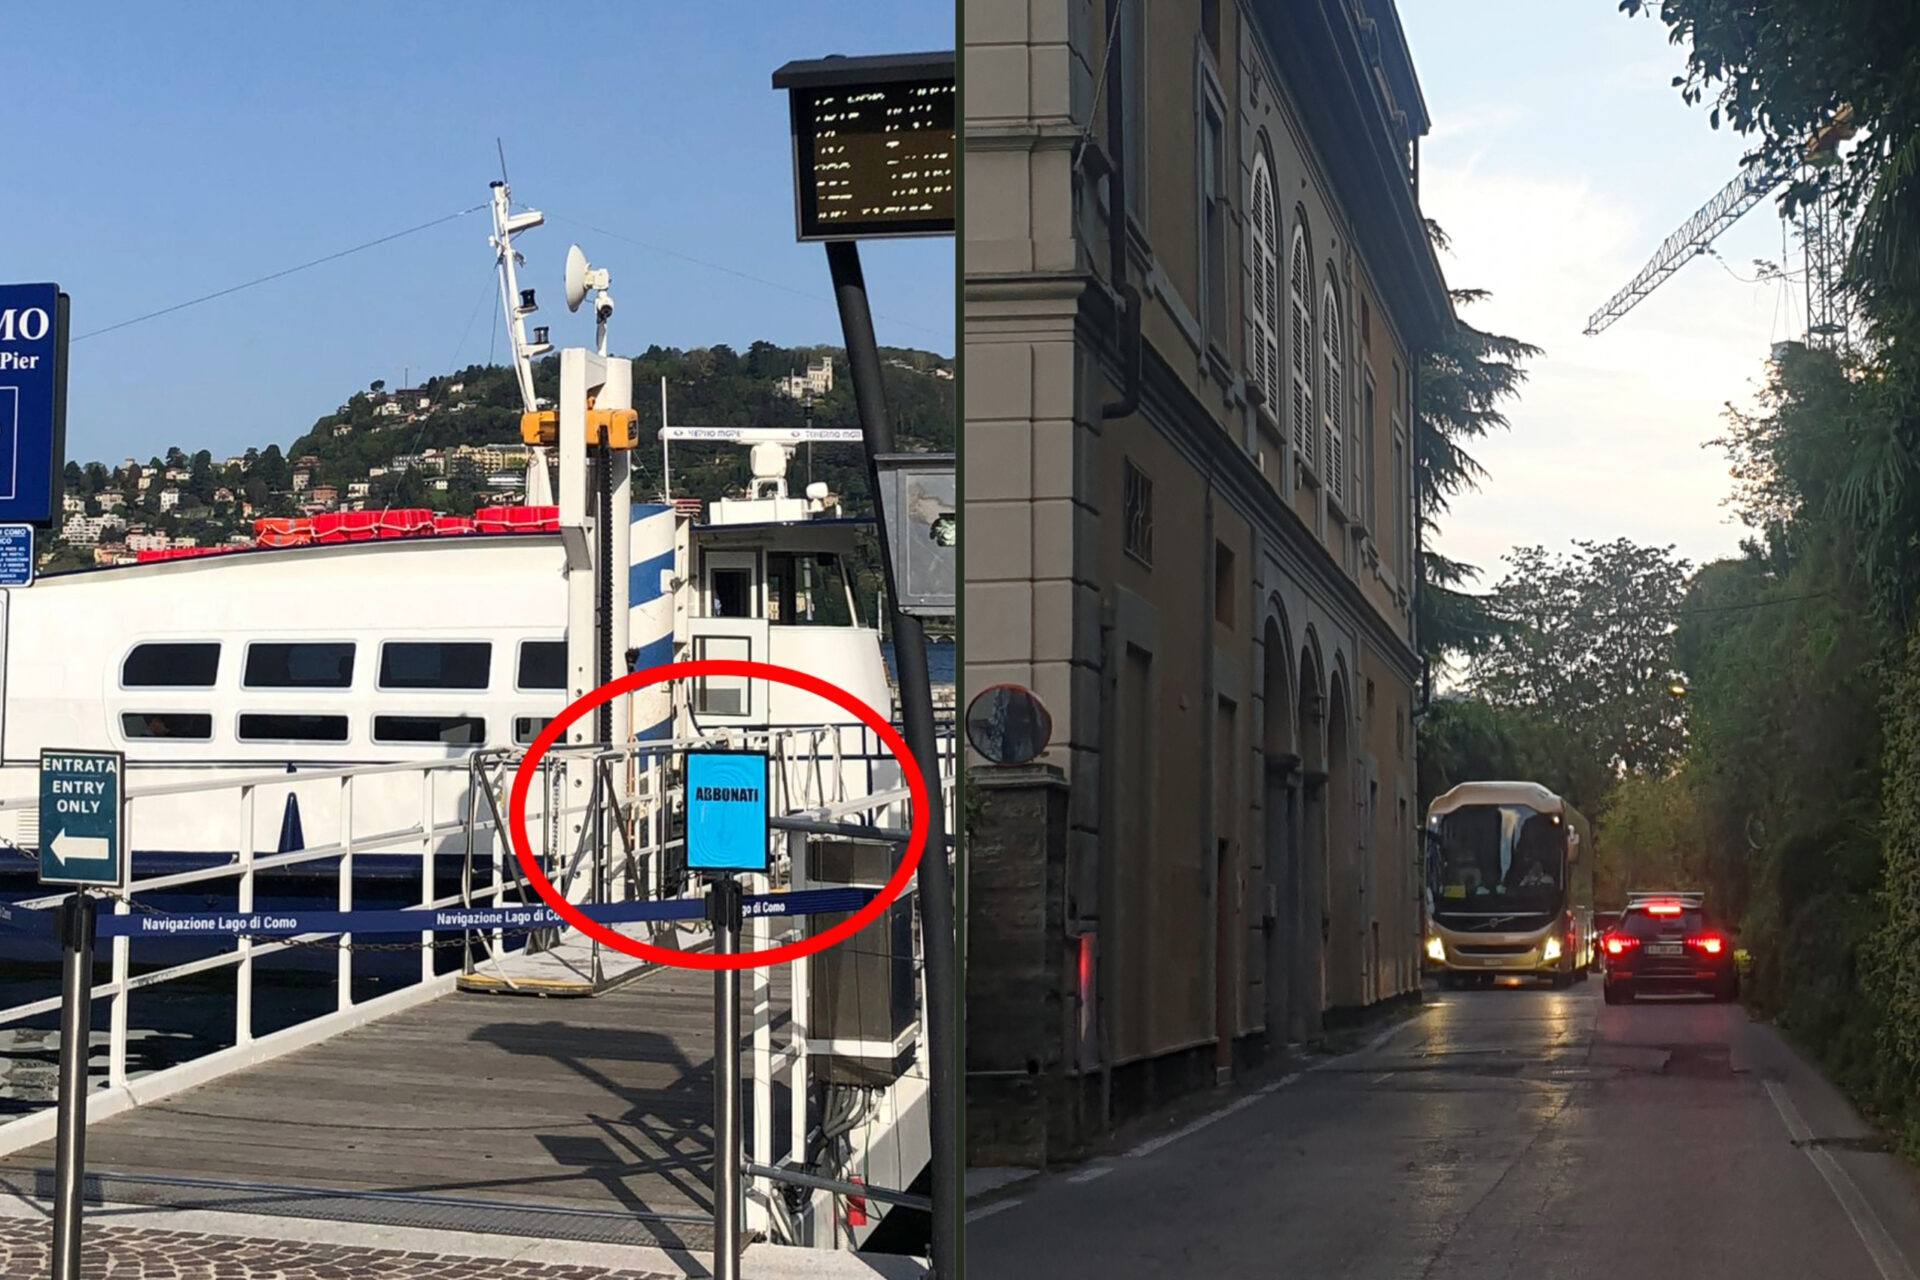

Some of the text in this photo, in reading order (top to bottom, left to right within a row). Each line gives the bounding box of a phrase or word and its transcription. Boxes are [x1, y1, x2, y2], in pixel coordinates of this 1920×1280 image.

[0, 351, 39, 370] Pier
[42, 757, 116, 774] ENTRATA
[52, 779, 106, 795] ENTRY
[695, 786, 760, 803] ABBONATI
[56, 798, 101, 814] ONLY
[753, 902, 761, 913] di
[762, 901, 786, 913] Como
[142, 915, 297, 933] Navigazione Lago di Como
[436, 909, 563, 928] Navigazione Lago di Co
